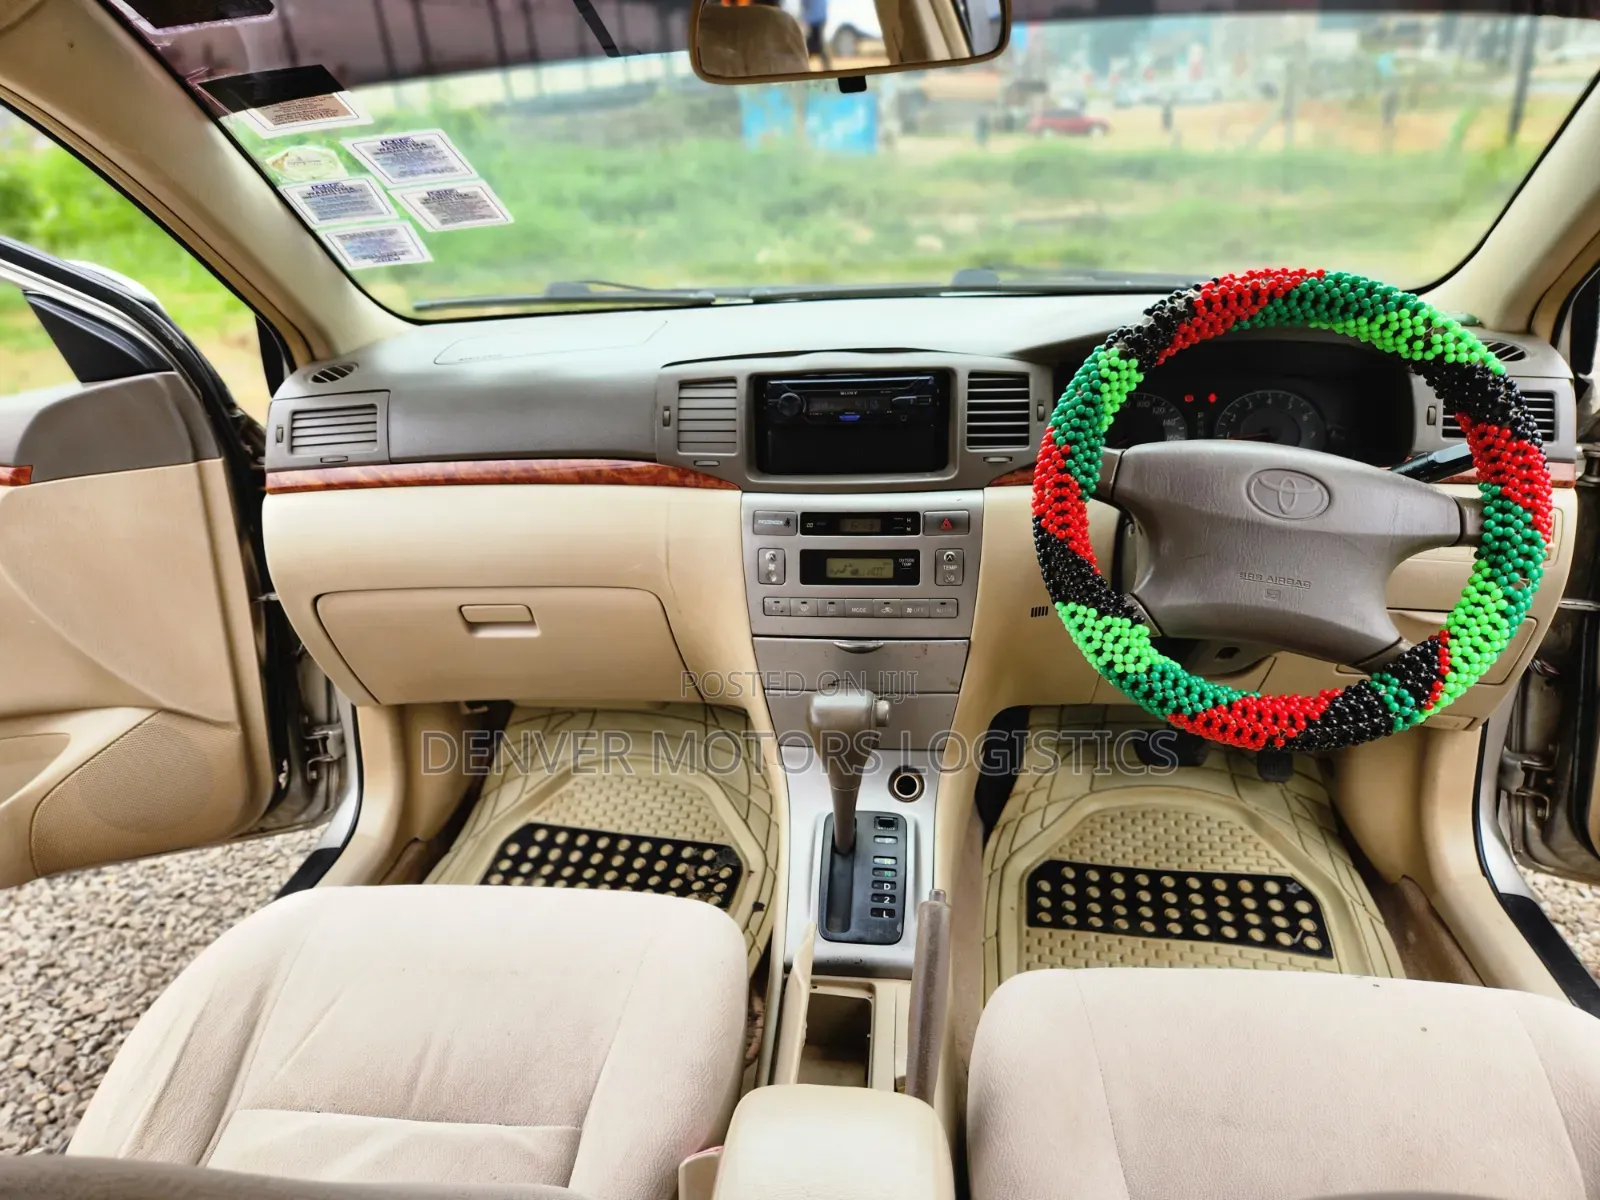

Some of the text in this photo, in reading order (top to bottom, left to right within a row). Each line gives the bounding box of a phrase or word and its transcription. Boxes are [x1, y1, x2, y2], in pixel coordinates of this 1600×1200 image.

[1265, 574, 1312, 590] AIRBAG
[883, 882, 891, 890] D
[883, 896, 890, 904] 2
[882, 910, 889, 918] L
